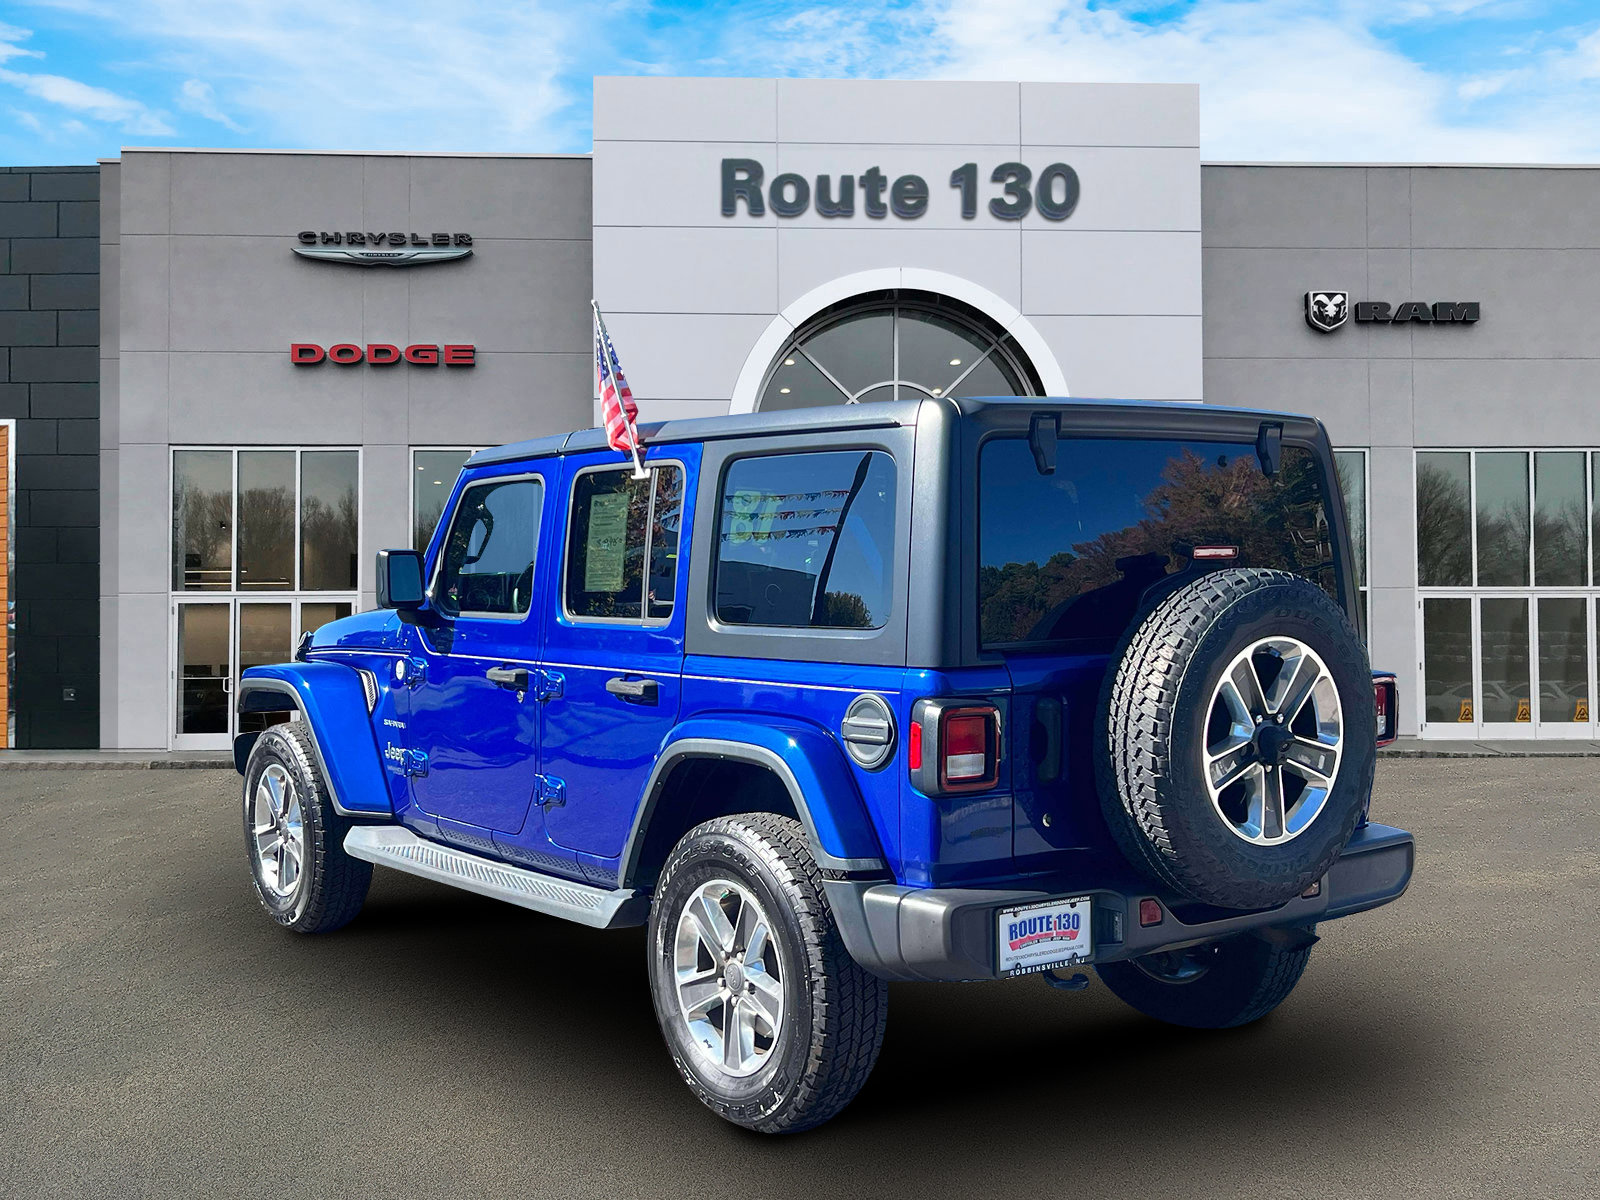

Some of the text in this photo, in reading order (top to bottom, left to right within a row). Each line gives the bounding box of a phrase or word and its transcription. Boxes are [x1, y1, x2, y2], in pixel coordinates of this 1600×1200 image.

[721, 158, 1081, 221] Route 130
[298, 231, 473, 246] CHRYSLER
[1354, 301, 1480, 325] RAM
[291, 343, 476, 366] DODGE
[384, 741, 406, 766] Jeep
[653, 839, 760, 908] BRIDGESTONE
[1009, 913, 1080, 941] ROUTE 130
[1010, 957, 1085, 976] ROBBINSVILLE, NJ
